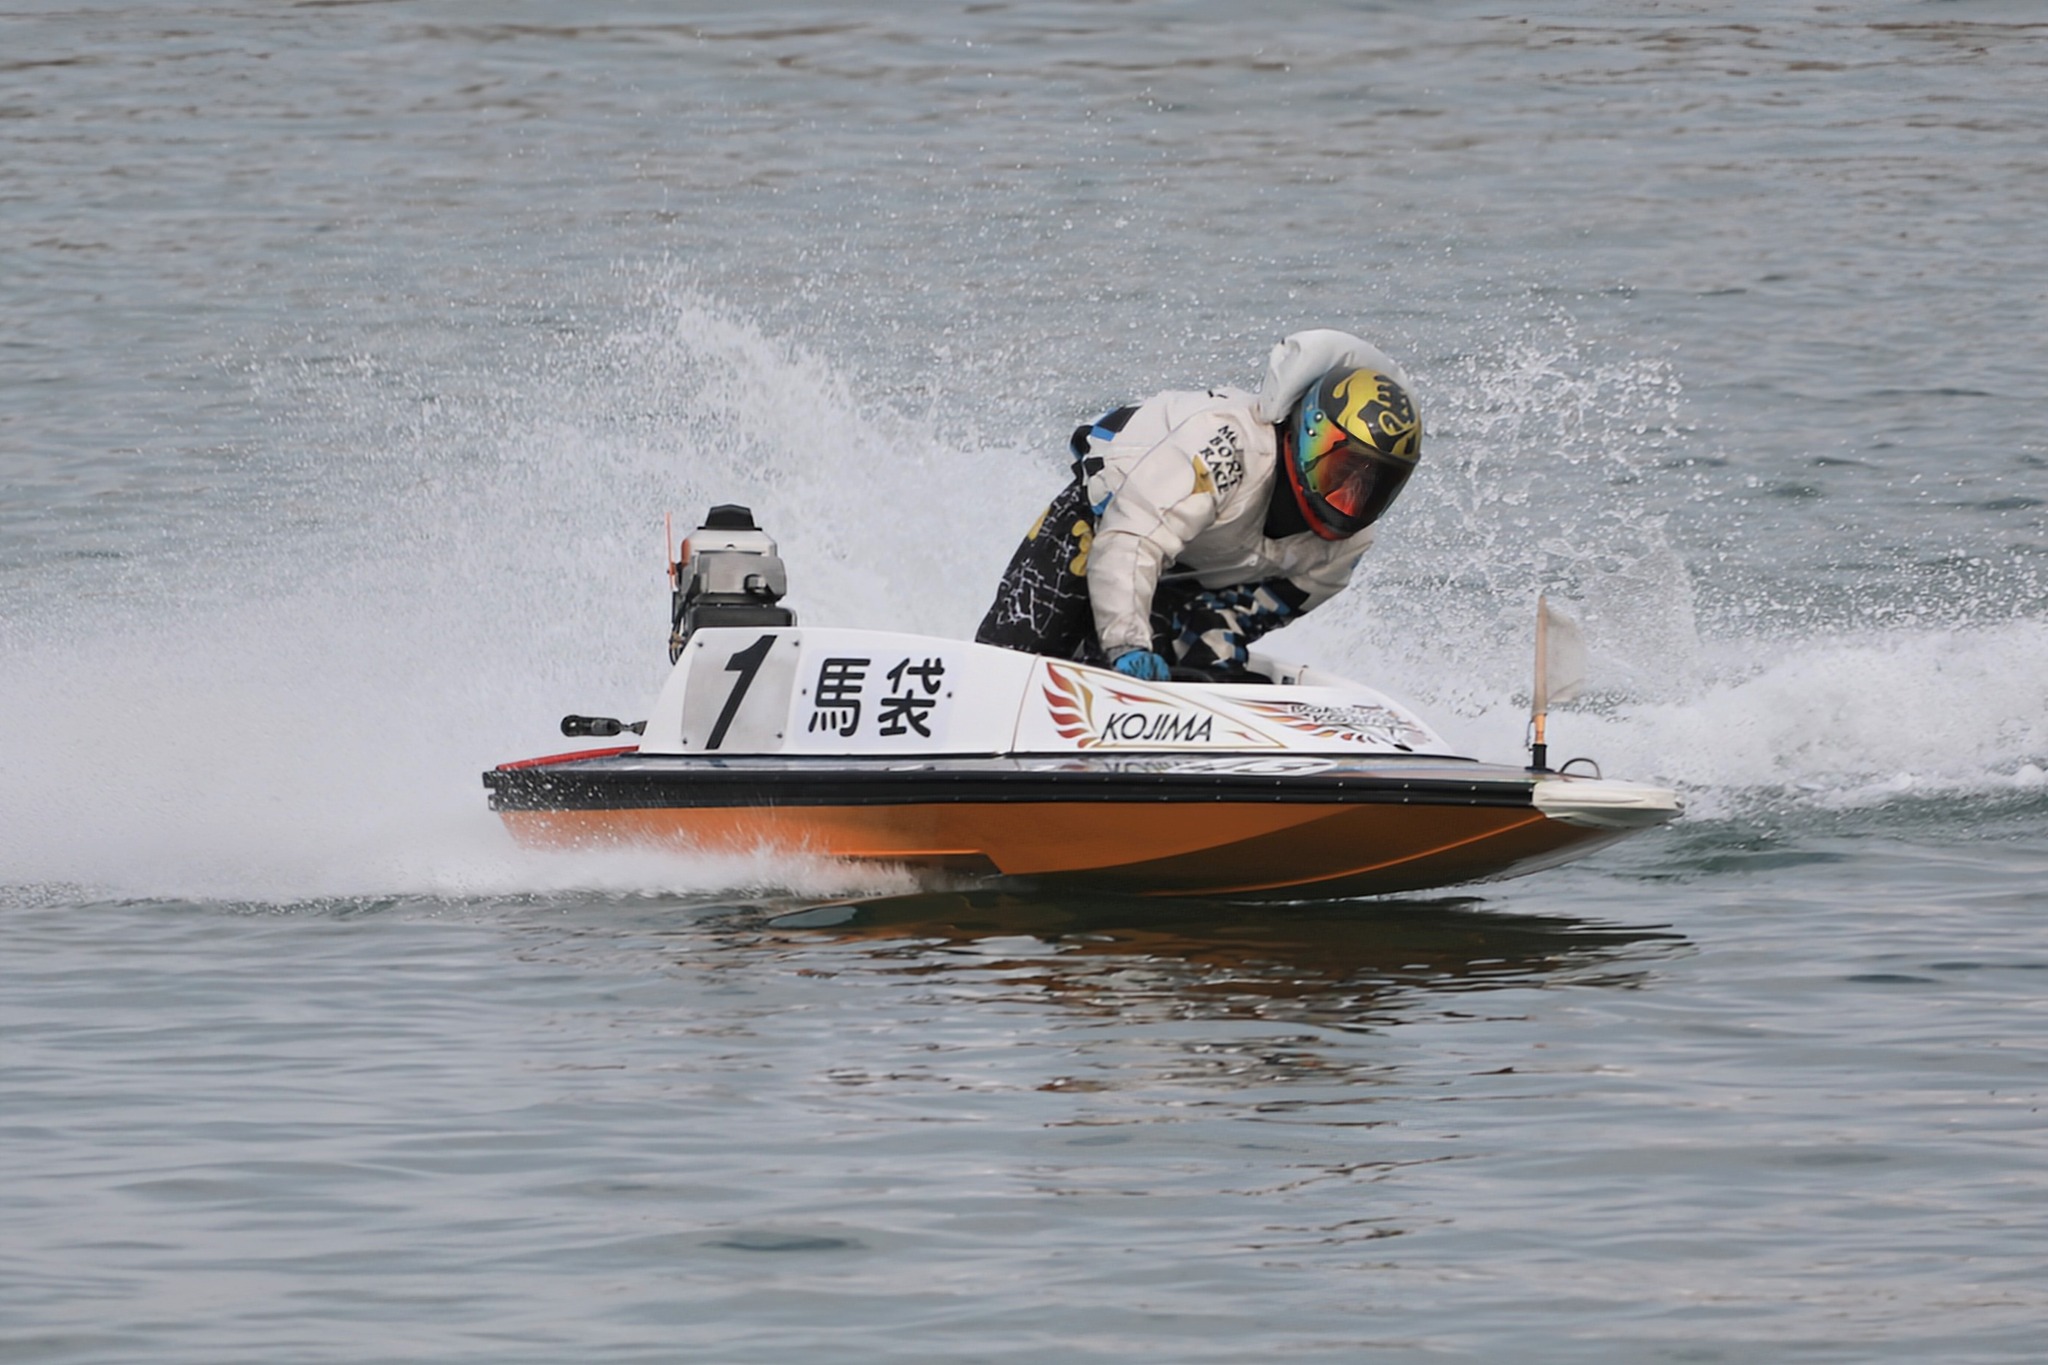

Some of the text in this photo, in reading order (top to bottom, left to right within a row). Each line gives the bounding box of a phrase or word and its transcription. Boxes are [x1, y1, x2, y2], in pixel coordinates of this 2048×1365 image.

[705, 635, 778, 750] 1
[808, 657, 946, 738] 馬袋
[1100, 712, 1213, 742] KOJIMA
